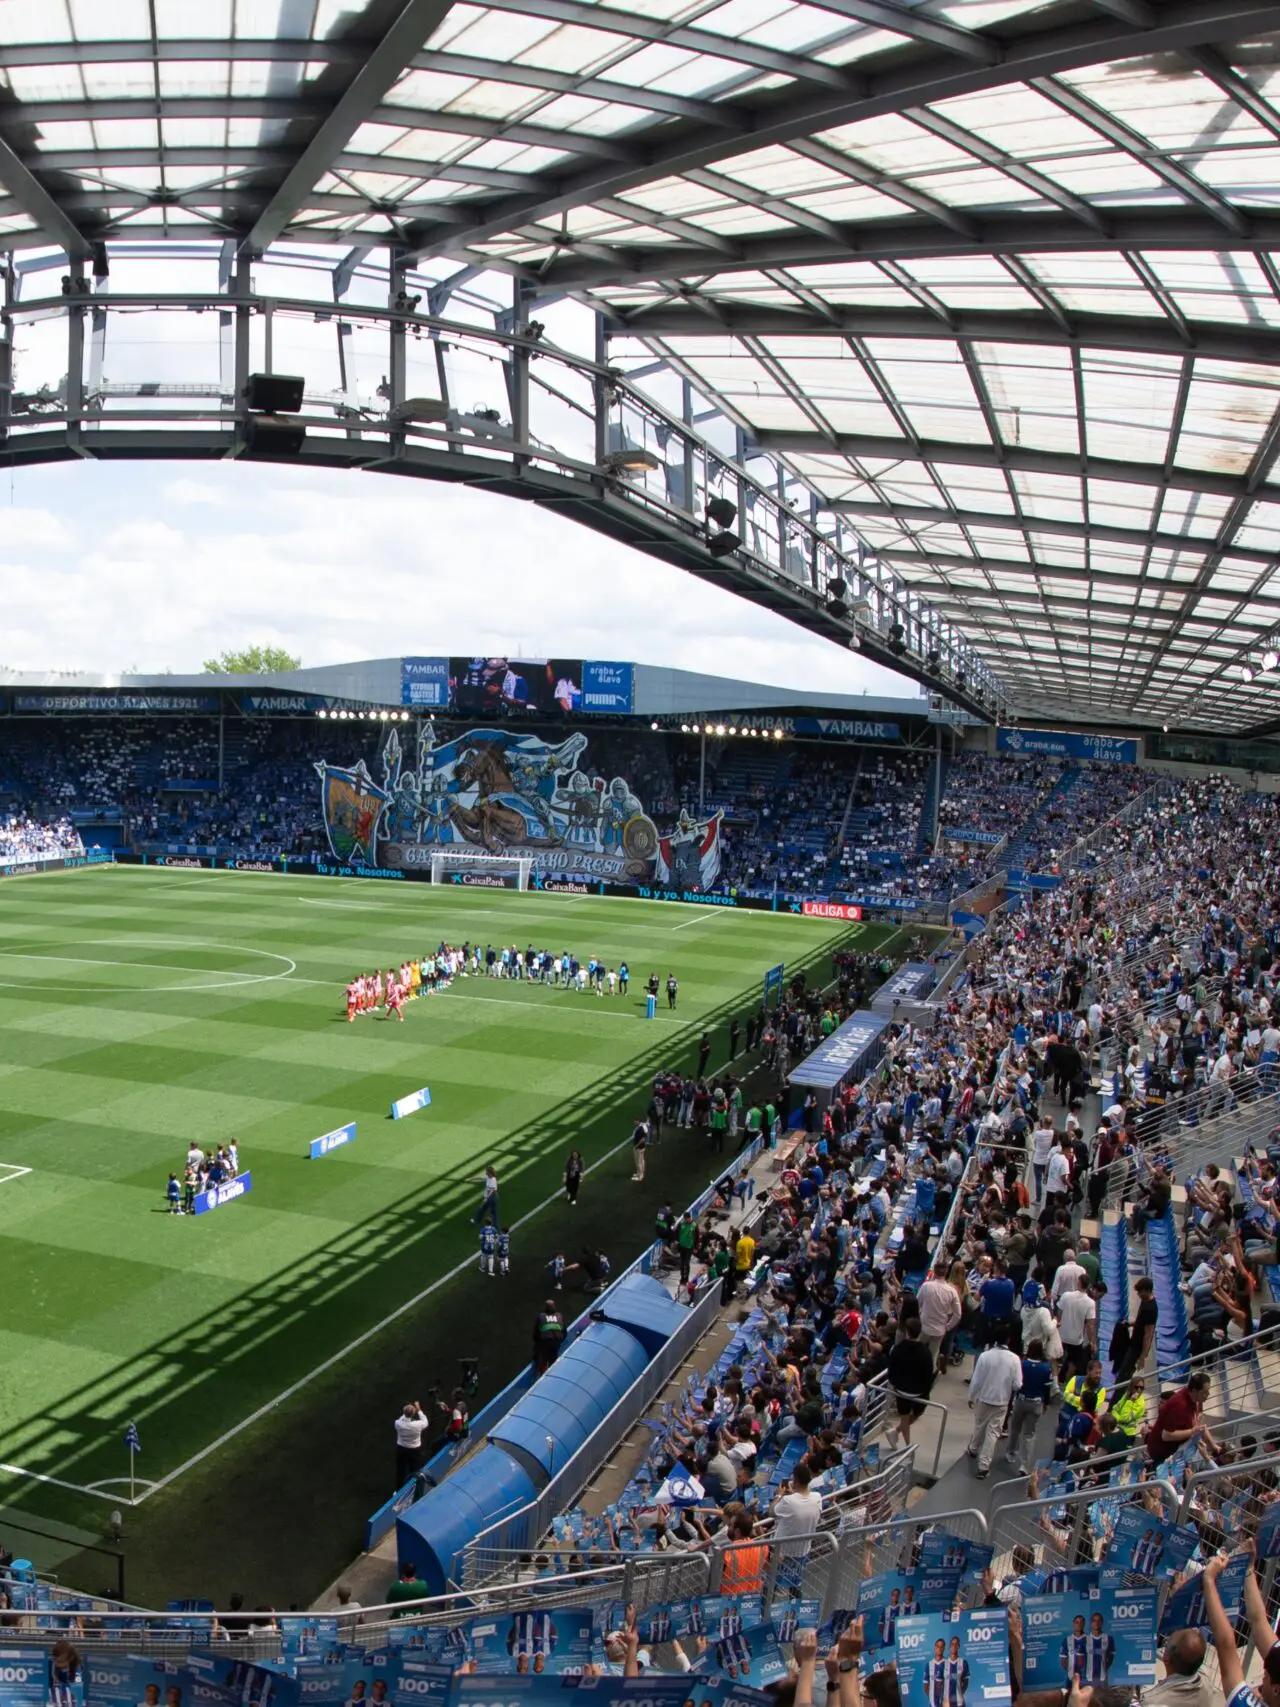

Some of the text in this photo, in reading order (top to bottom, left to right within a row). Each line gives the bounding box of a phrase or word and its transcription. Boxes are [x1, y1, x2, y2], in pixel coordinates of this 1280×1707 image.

[412, 664, 445, 674] AMBAR
[261, 697, 307, 710] AMBAR
[585, 693, 616, 705] PUMA
[829, 718, 886, 738] AMBAR
[1083, 735, 1114, 748] araba
[236, 860, 273, 871] CaixaBank
[330, 866, 336, 875] y
[357, 867, 405, 879] Nosotros.
[545, 881, 588, 894] CaixaBank
[639, 886, 651, 896] Tú
[654, 890, 660, 900] y
[684, 893, 738, 906] Nosotros.
[804, 903, 844, 917] LALIGA
[1111, 1604, 1145, 1618] 100€
[1026, 1611, 1060, 1626] 100€
[899, 1634, 927, 1649] 100€
[967, 1627, 997, 1642] 100€
[89, 1670, 131, 1685] 100€
[397, 1677, 437, 1694] 100€
